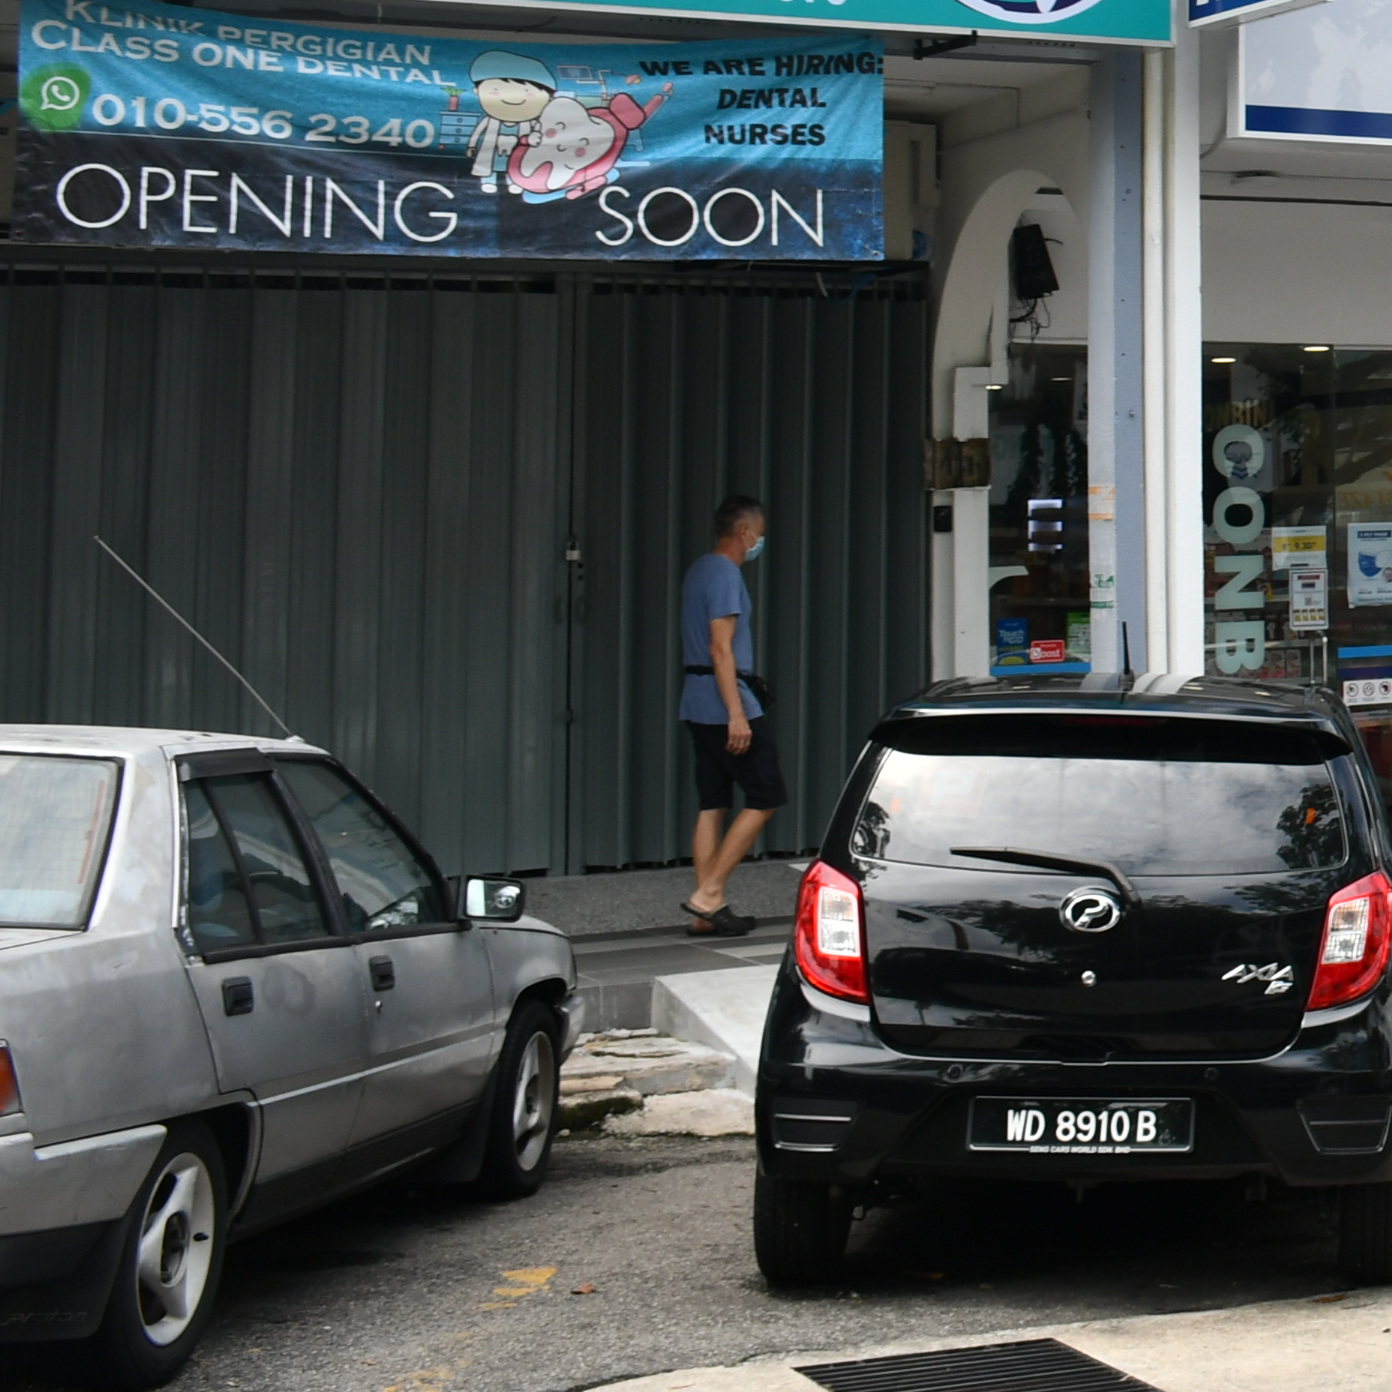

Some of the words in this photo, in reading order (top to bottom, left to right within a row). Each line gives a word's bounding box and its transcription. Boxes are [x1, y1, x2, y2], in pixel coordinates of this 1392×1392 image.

[31, 19, 180, 63] CLASS
[192, 42, 284, 73] ONE
[296, 56, 457, 87] DENTAL
[217, 25, 431, 66] PERGIGIAN
[640, 60, 693, 78] WE
[703, 58, 766, 78] ARE
[773, 52, 884, 79] HIRING:
[717, 85, 826, 112] DENTAL
[92, 93, 293, 139] 010-556
[305, 113, 434, 149] 2340
[704, 123, 826, 147] NURSES
[56, 164, 458, 244] OPENING
[595, 185, 823, 248] SOON
[1221, 962, 1294, 984] AXIA
[1006, 1109, 1046, 1141] WD
[1055, 1110, 1131, 1142] 8910
[1136, 1110, 1157, 1142] B
